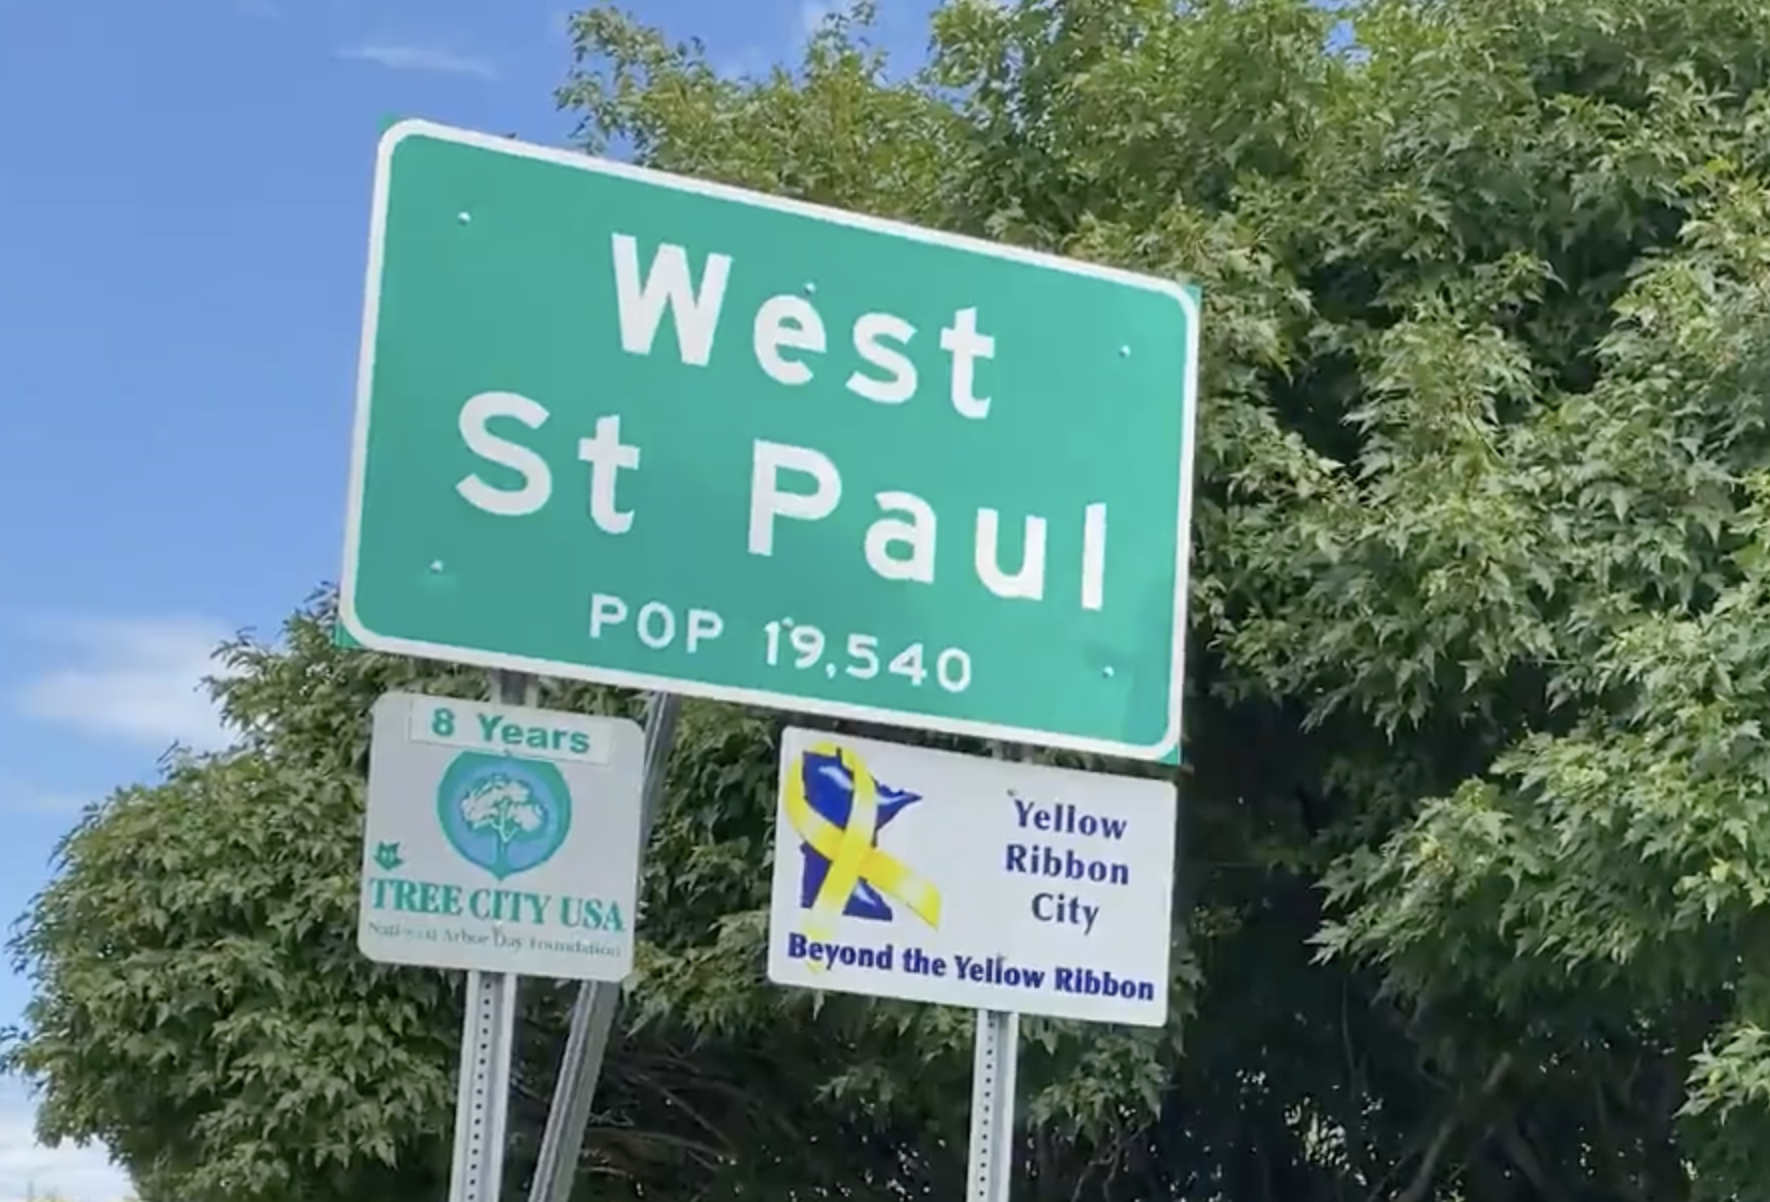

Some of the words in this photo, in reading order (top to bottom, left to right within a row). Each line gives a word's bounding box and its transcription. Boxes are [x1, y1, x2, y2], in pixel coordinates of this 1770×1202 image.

[611, 231, 996, 420] West
[455, 390, 641, 535] St
[748, 438, 1108, 612] Paul
[588, 592, 725, 655] POP
[764, 622, 973, 694] 19,540
[431, 707, 455, 737] 8
[477, 712, 591, 755] Years
[1013, 799, 1127, 840] Yellow
[1005, 843, 1130, 885] Ribbon
[369, 877, 463, 917] TREE
[469, 888, 552, 925] CITY
[560, 896, 626, 932] USA
[1031, 893, 1100, 935] City
[493, 928, 523, 950] Day
[530, 938, 621, 958] Foundation
[787, 931, 894, 970] Beyond
[901, 947, 947, 977] the
[954, 954, 1045, 990] Yellow
[1054, 966, 1155, 1001] Ribbon
